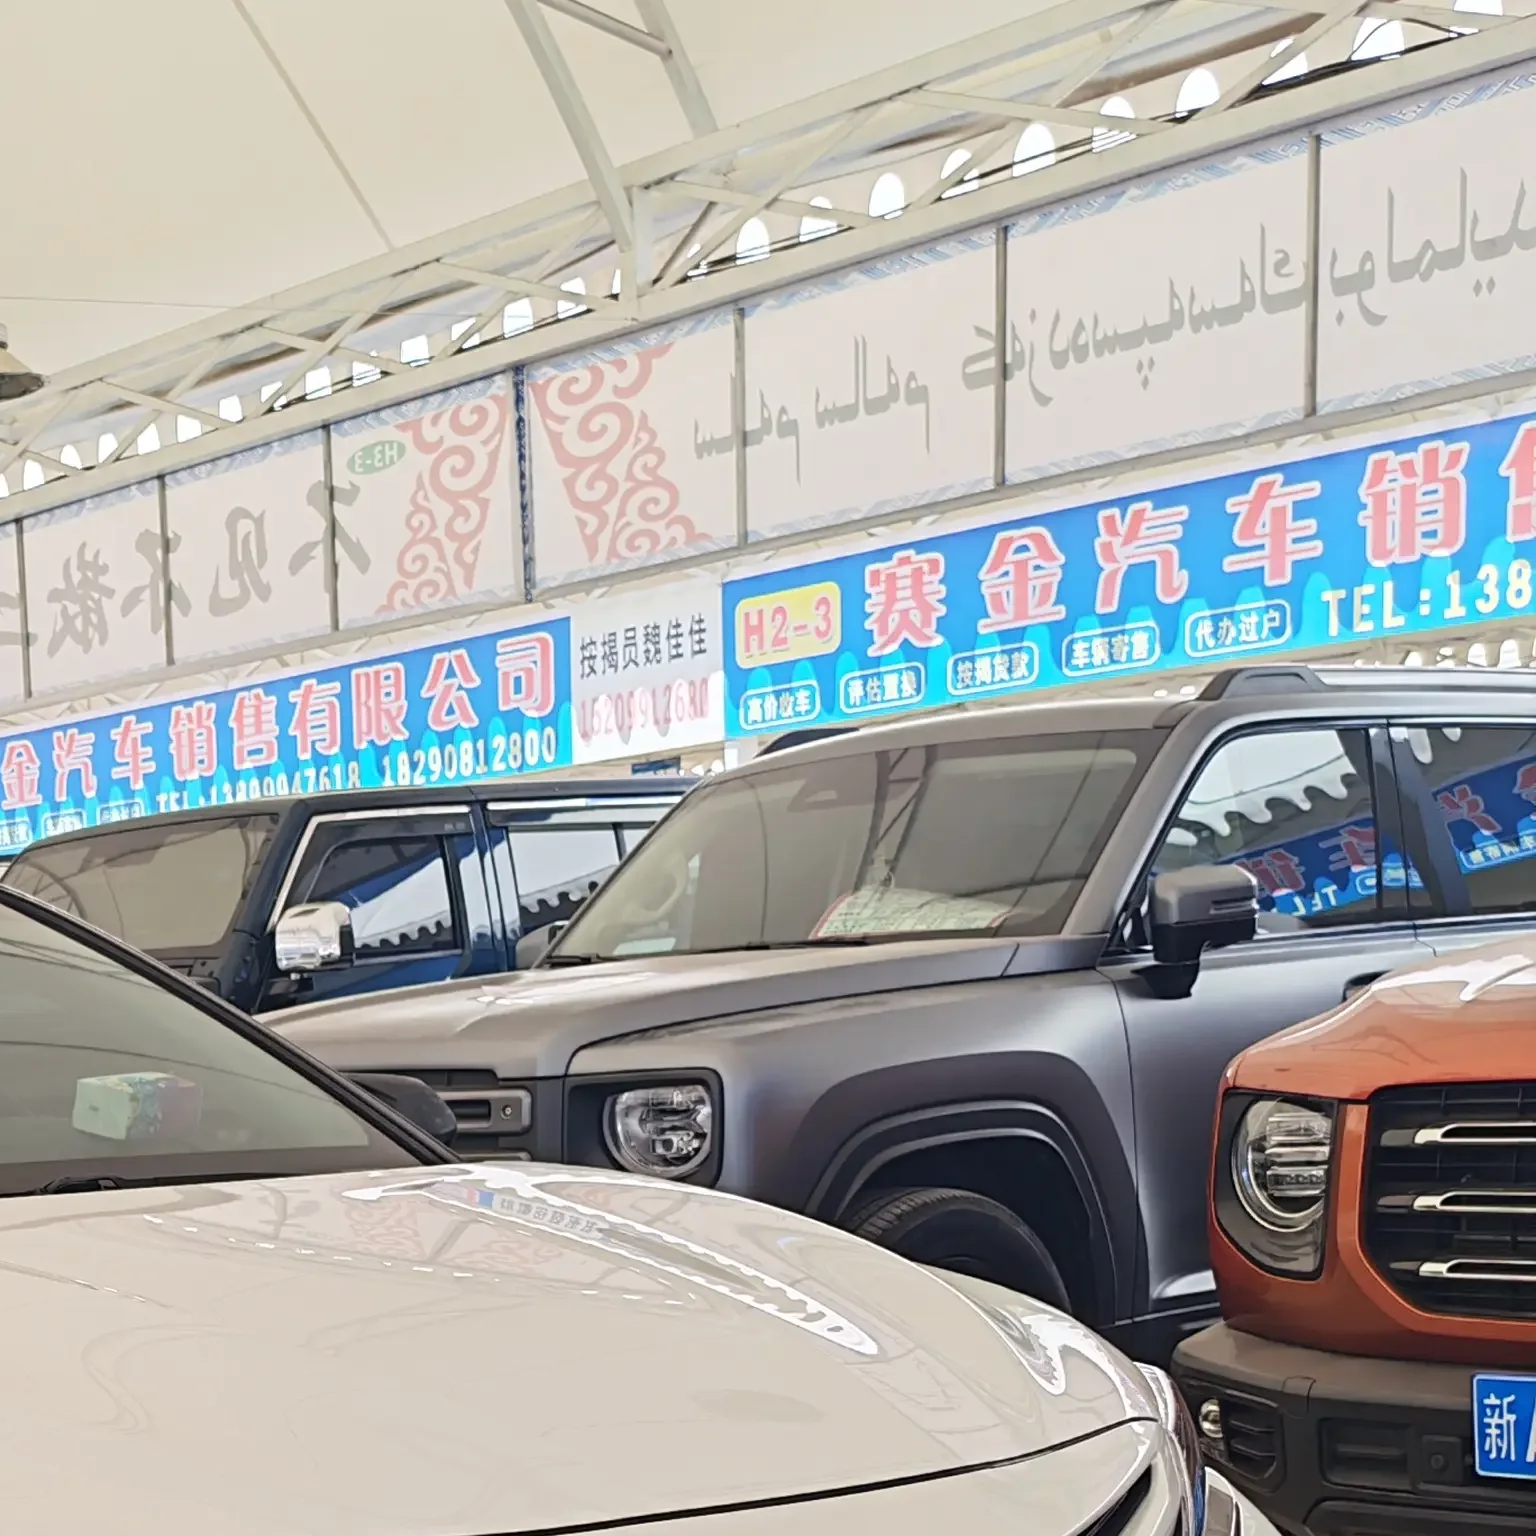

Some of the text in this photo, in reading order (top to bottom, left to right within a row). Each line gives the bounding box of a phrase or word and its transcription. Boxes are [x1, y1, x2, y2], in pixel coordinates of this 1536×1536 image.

[580, 613, 707, 680] 按揭员魏佳佳
[743, 596, 833, 654] H2-3
[382, 726, 557, 786] 18290812800
